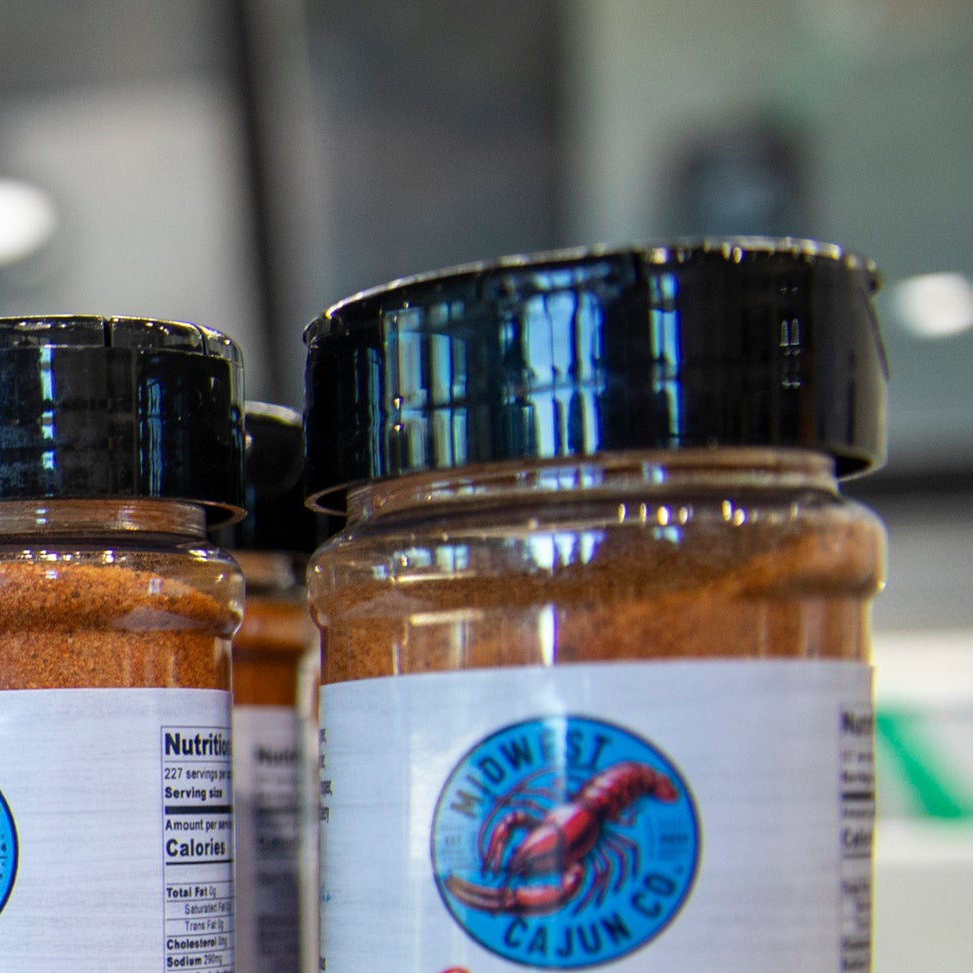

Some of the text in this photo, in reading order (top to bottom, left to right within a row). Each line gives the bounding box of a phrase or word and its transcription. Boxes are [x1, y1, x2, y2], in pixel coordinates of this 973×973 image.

[164, 767, 183, 780] 227
[186, 769, 217, 782] servings
[450, 730, 613, 820] MIDWEST
[165, 786, 207, 802] Serving
[165, 819, 204, 831] Amount
[206, 820, 217, 832] per
[165, 838, 226, 857] Calories
[167, 887, 192, 898] Total
[195, 886, 207, 897] Fat
[504, 865, 684, 959] CAJUN CO.
[186, 921, 205, 932] Trans
[167, 939, 216, 950] Cholesterol
[167, 956, 202, 968] Sodium
